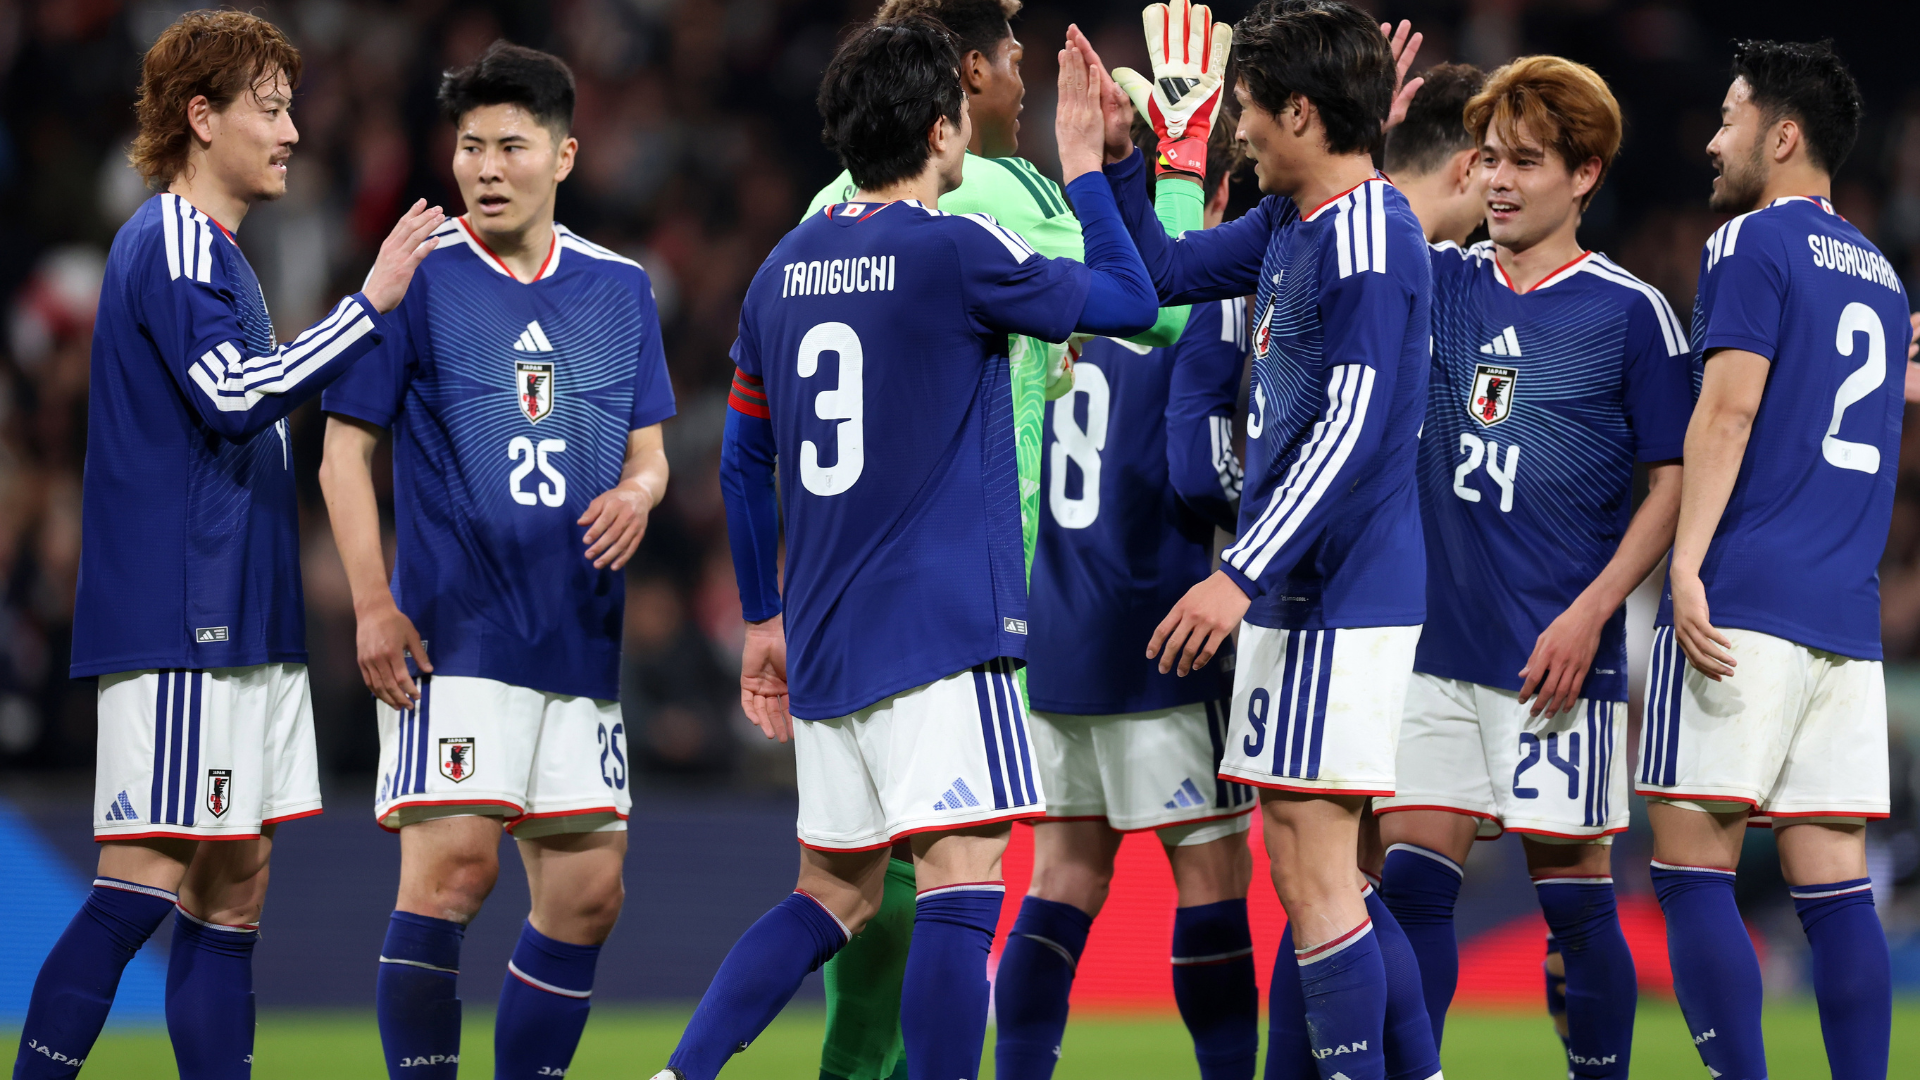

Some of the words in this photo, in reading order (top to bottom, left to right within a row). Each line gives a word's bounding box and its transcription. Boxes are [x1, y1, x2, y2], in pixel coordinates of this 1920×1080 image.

[783, 255, 895, 298] TANIGUCHI
[1486, 367, 1508, 376] JAPAN
[1822, 302, 1887, 475] 2
[527, 403, 541, 413] JFA
[797, 322, 865, 497] 3
[1479, 406, 1498, 418] JFA
[508, 436, 566, 508] 25
[1049, 362, 1110, 529] 8
[1453, 433, 1520, 513] 24
[597, 722, 626, 791] 25
[1243, 687, 1270, 758] 9
[449, 768, 465, 777] JFA
[1512, 731, 1581, 800] 24
[400, 1054, 460, 1068] JAPA
